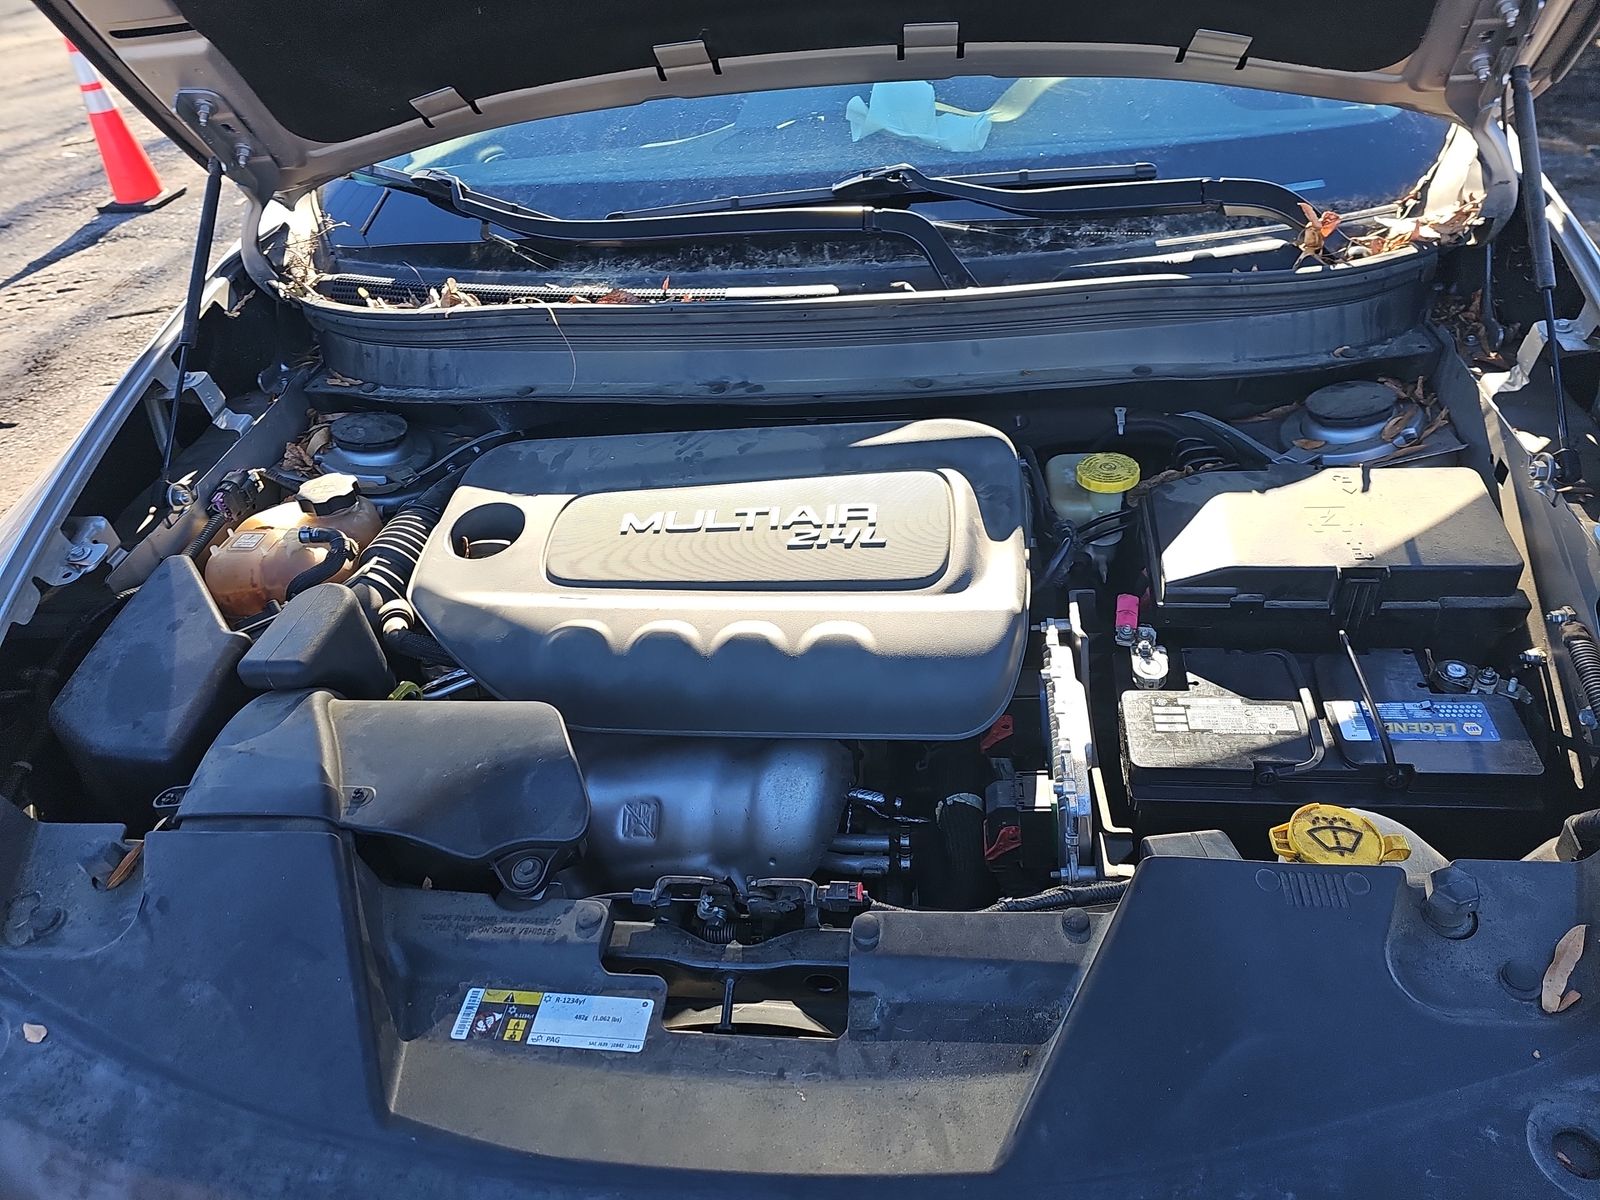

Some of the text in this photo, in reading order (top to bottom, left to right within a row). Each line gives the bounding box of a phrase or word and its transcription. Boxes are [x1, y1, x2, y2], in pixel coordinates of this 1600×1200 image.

[620, 503, 878, 535] MULTIAIR
[786, 527, 887, 551] 2.4L
[473, 914, 498, 923] PANEL
[491, 926, 516, 936] SOME
[555, 996, 587, 1005] R-1234yf
[545, 1036, 560, 1044] PAG
